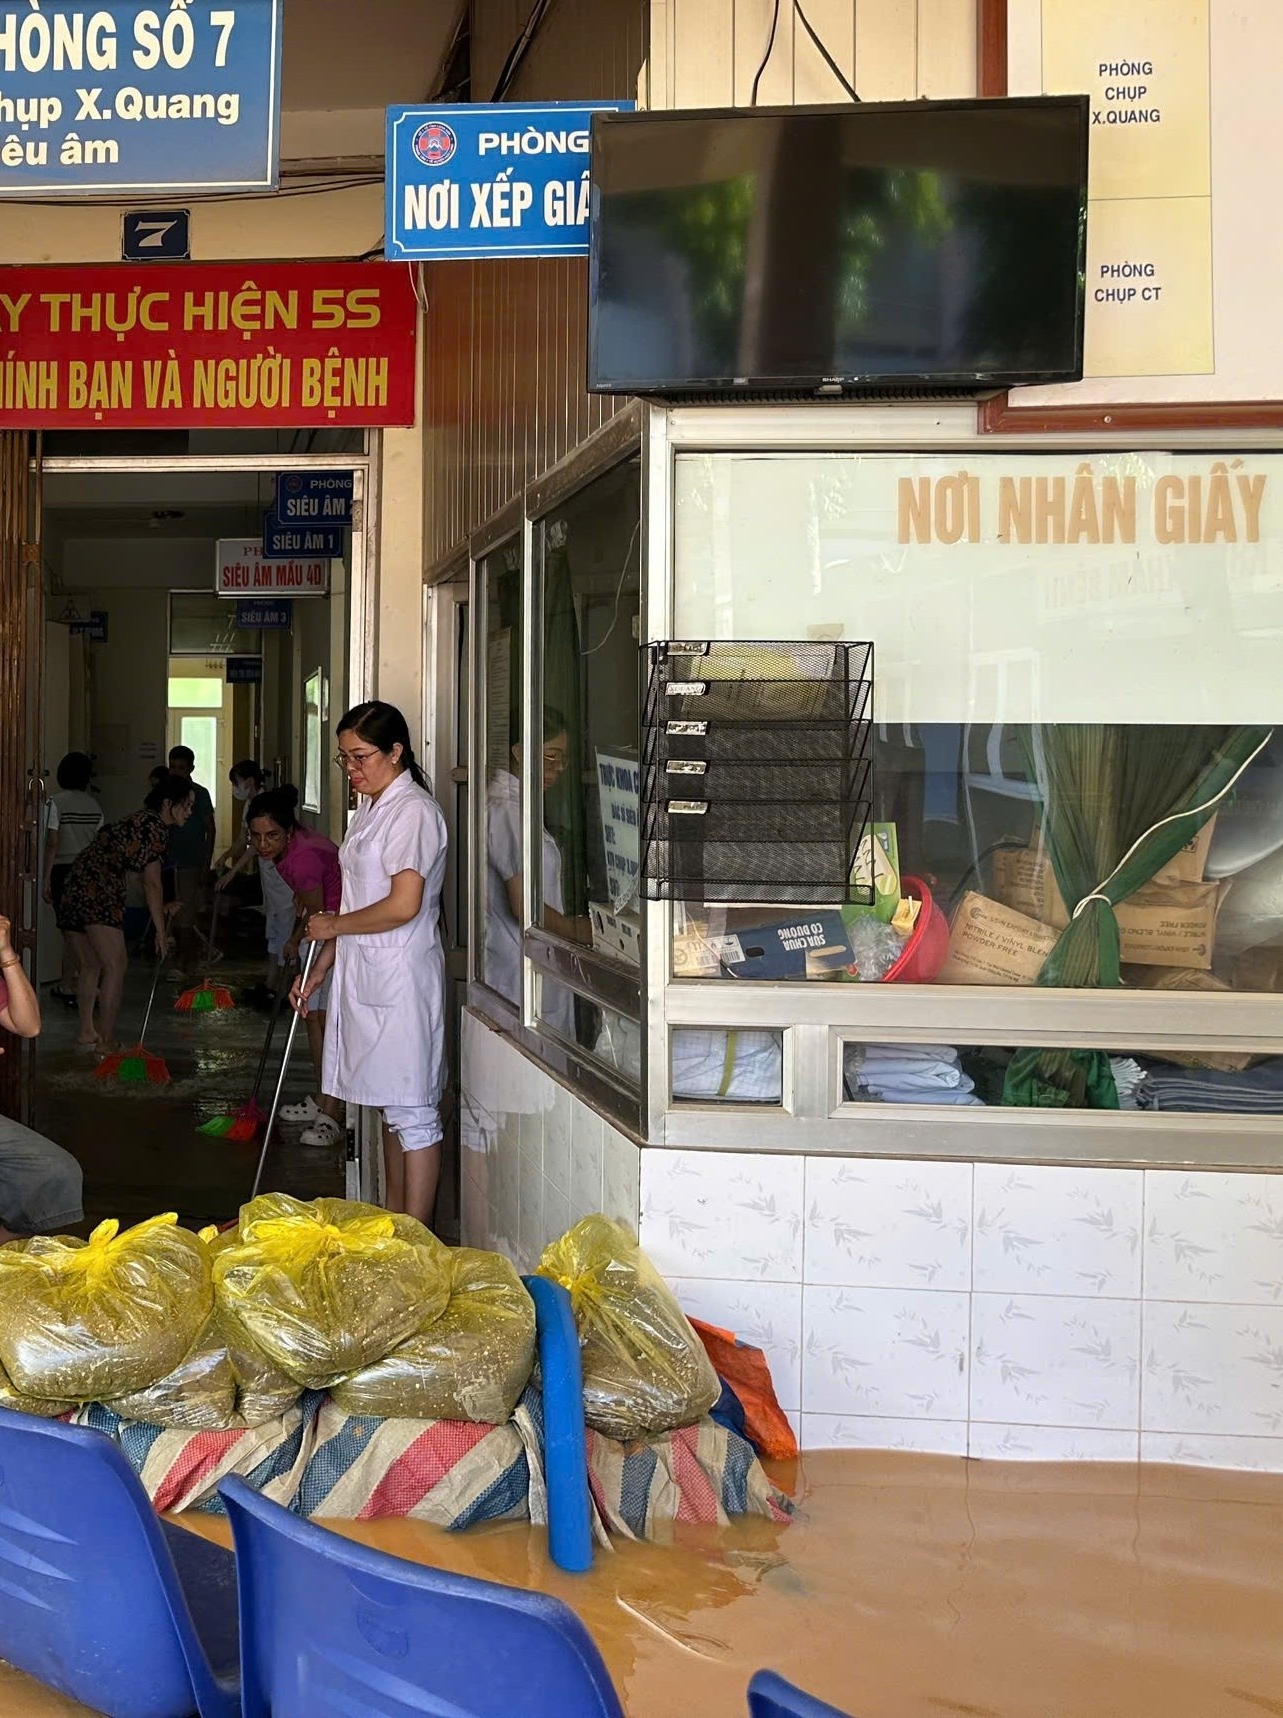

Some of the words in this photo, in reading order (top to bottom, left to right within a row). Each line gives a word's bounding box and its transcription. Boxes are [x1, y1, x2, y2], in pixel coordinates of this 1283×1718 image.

[133, 0, 196, 69] SỐ
[210, 11, 236, 67] 7
[1099, 59, 1153, 77] PHÒNG
[75, 87, 241, 125] X.Quang
[1105, 86, 1147, 103] CHỤP
[1092, 109, 1161, 125] X.QUANG
[60, 133, 119, 165] âm
[478, 126, 589, 156] PHÒNG
[404, 179, 460, 230] NƠI
[470, 167, 533, 228] XẾP
[543, 170, 589, 226] GIÂ
[134, 220, 178, 247] 7
[1100, 261, 1155, 278] PHÒNG
[1094, 288, 1137, 304] CHỤP
[1142, 287, 1161, 301] CT
[40, 287, 169, 342] THỰC
[184, 281, 299, 341] HIỆN
[312, 289, 381, 329] 5S
[68, 361, 133, 420] BẠN
[143, 349, 184, 410] VÀ
[193, 346, 290, 408] NGƯỜI
[303, 347, 389, 419] BỆNH
[310, 478, 352, 488] PHÒNG
[287, 495, 318, 516] SIÊU
[322, 495, 345, 515] ÂM
[898, 471, 981, 545] NƠI
[999, 462, 1137, 545] NHÂN
[1154, 458, 1267, 545] GIẤY
[273, 531, 301, 550] SIÊU
[304, 531, 324, 549] ÂM
[328, 534, 334, 549] 1
[223, 562, 249, 588] SIÊU
[253, 562, 272, 587] ÂM
[307, 564, 321, 586] 4D
[1027, 945, 1048, 957] BLEN
